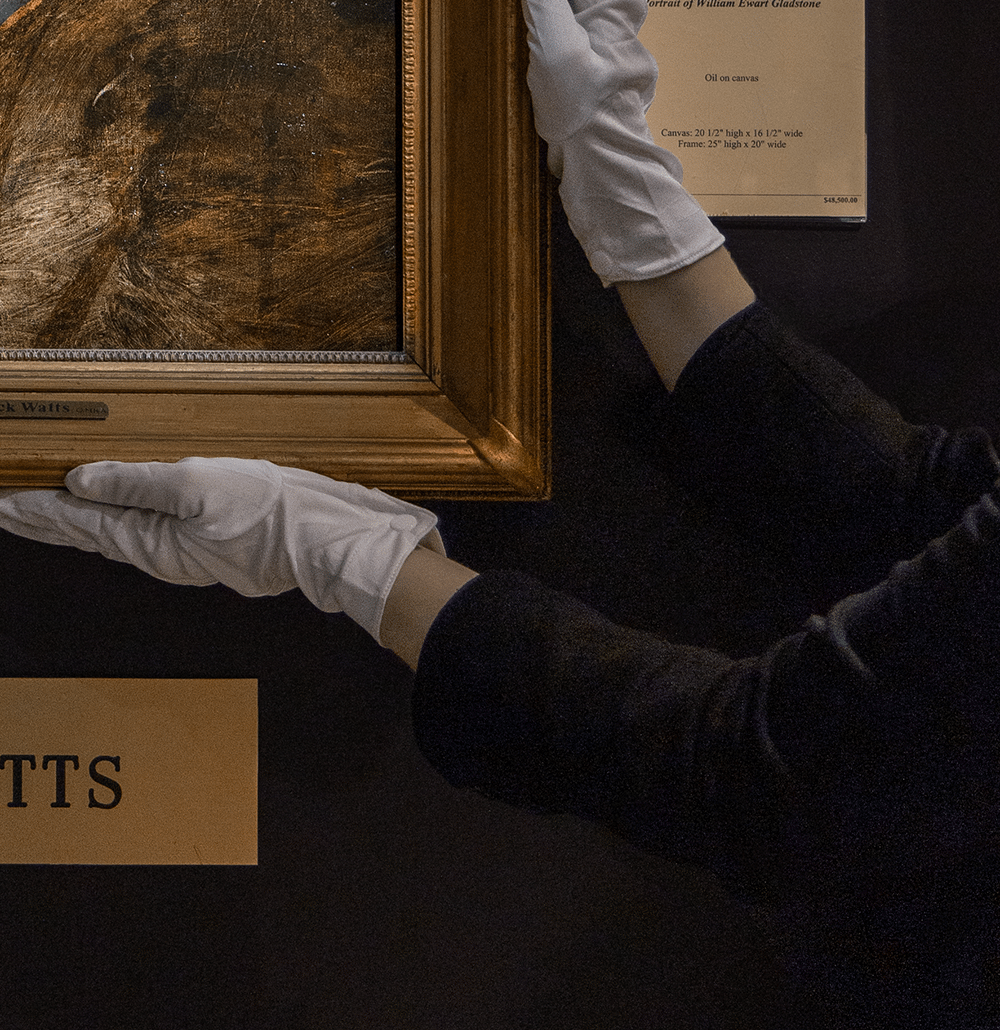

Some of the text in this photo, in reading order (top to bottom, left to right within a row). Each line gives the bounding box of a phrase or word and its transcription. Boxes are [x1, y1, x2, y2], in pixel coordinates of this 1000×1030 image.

[704, 73, 718, 82] Oil
[661, 128, 693, 137] Canvas:
[695, 128, 705, 137] 20
[726, 128, 744, 140] high
[754, 129, 764, 138] 16
[784, 129, 804, 138] wide
[678, 140, 706, 148] Frame:
[708, 140, 722, 148] 25"
[724, 139, 742, 151] high
[751, 140, 765, 148] 20"
[767, 140, 787, 148] wide
[823, 196, 859, 205] $48,500.00
[21, 401, 71, 414] Watts
